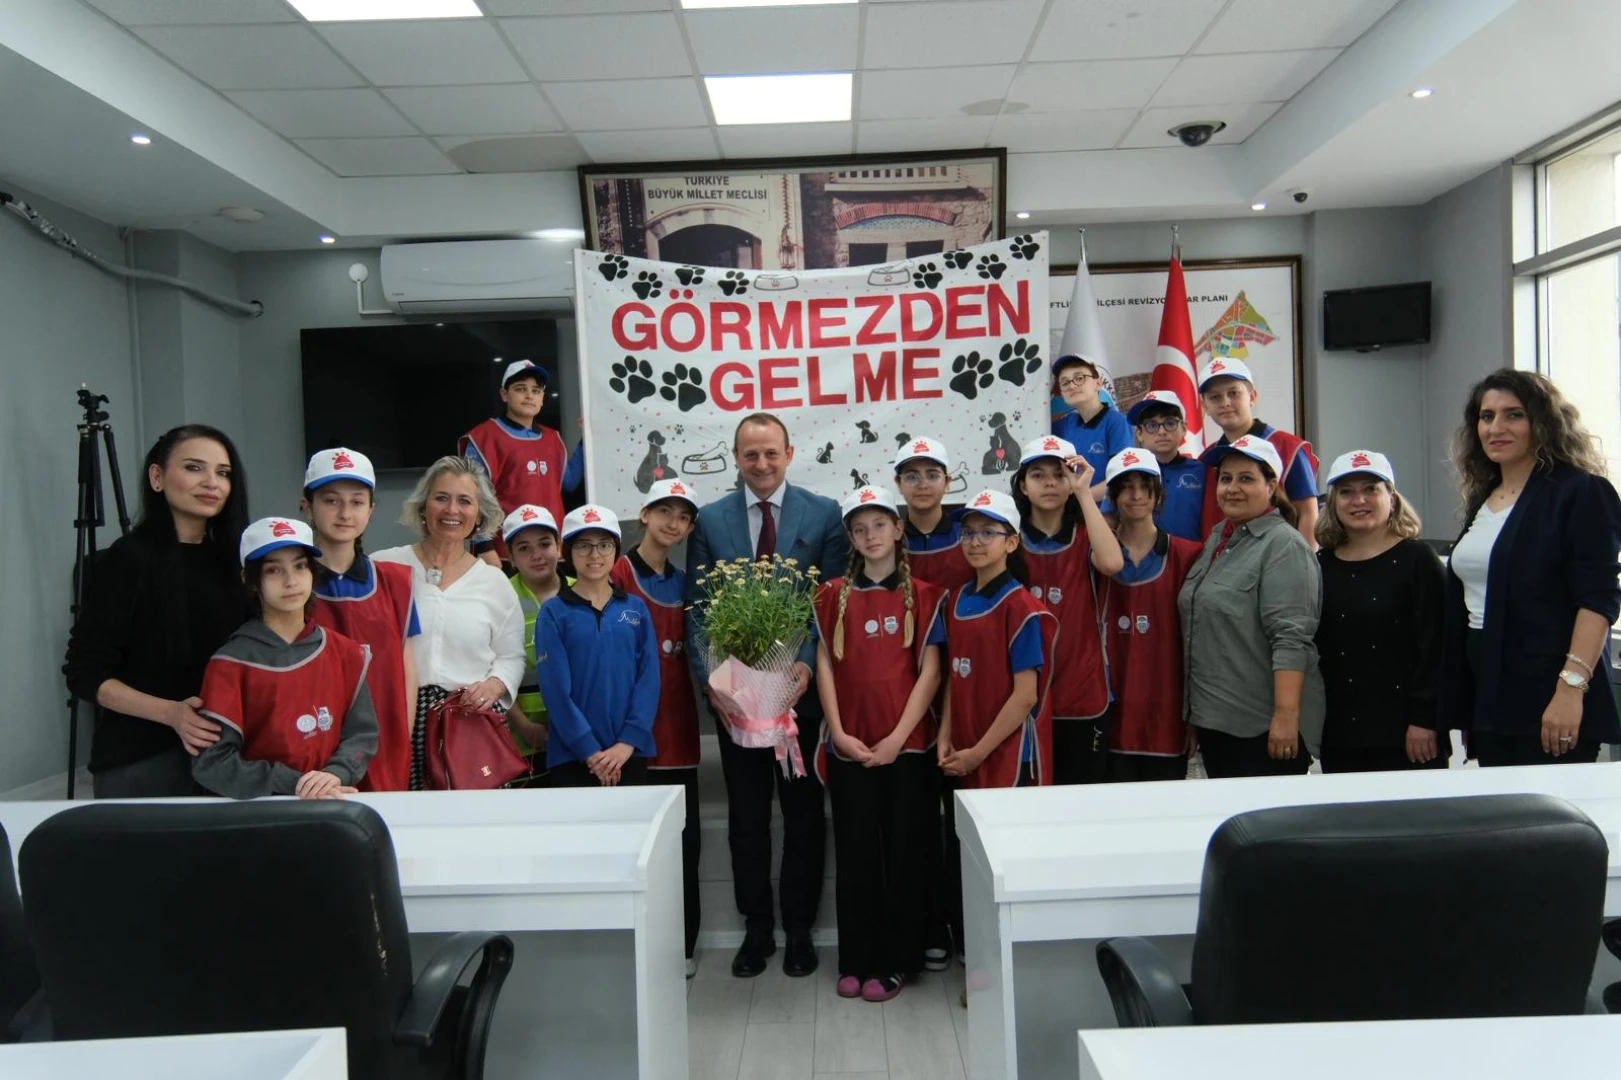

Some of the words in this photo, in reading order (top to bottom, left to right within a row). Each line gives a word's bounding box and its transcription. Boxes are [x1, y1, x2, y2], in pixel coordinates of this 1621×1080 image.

[647, 188, 684, 199] BÜYÜK
[687, 188, 723, 199] MİLLET
[727, 188, 767, 199] MECLİSİ
[611, 280, 1030, 353] GÖRMEZDEN
[1128, 295, 1166, 305] REVİZYO
[709, 348, 943, 411] GELME
